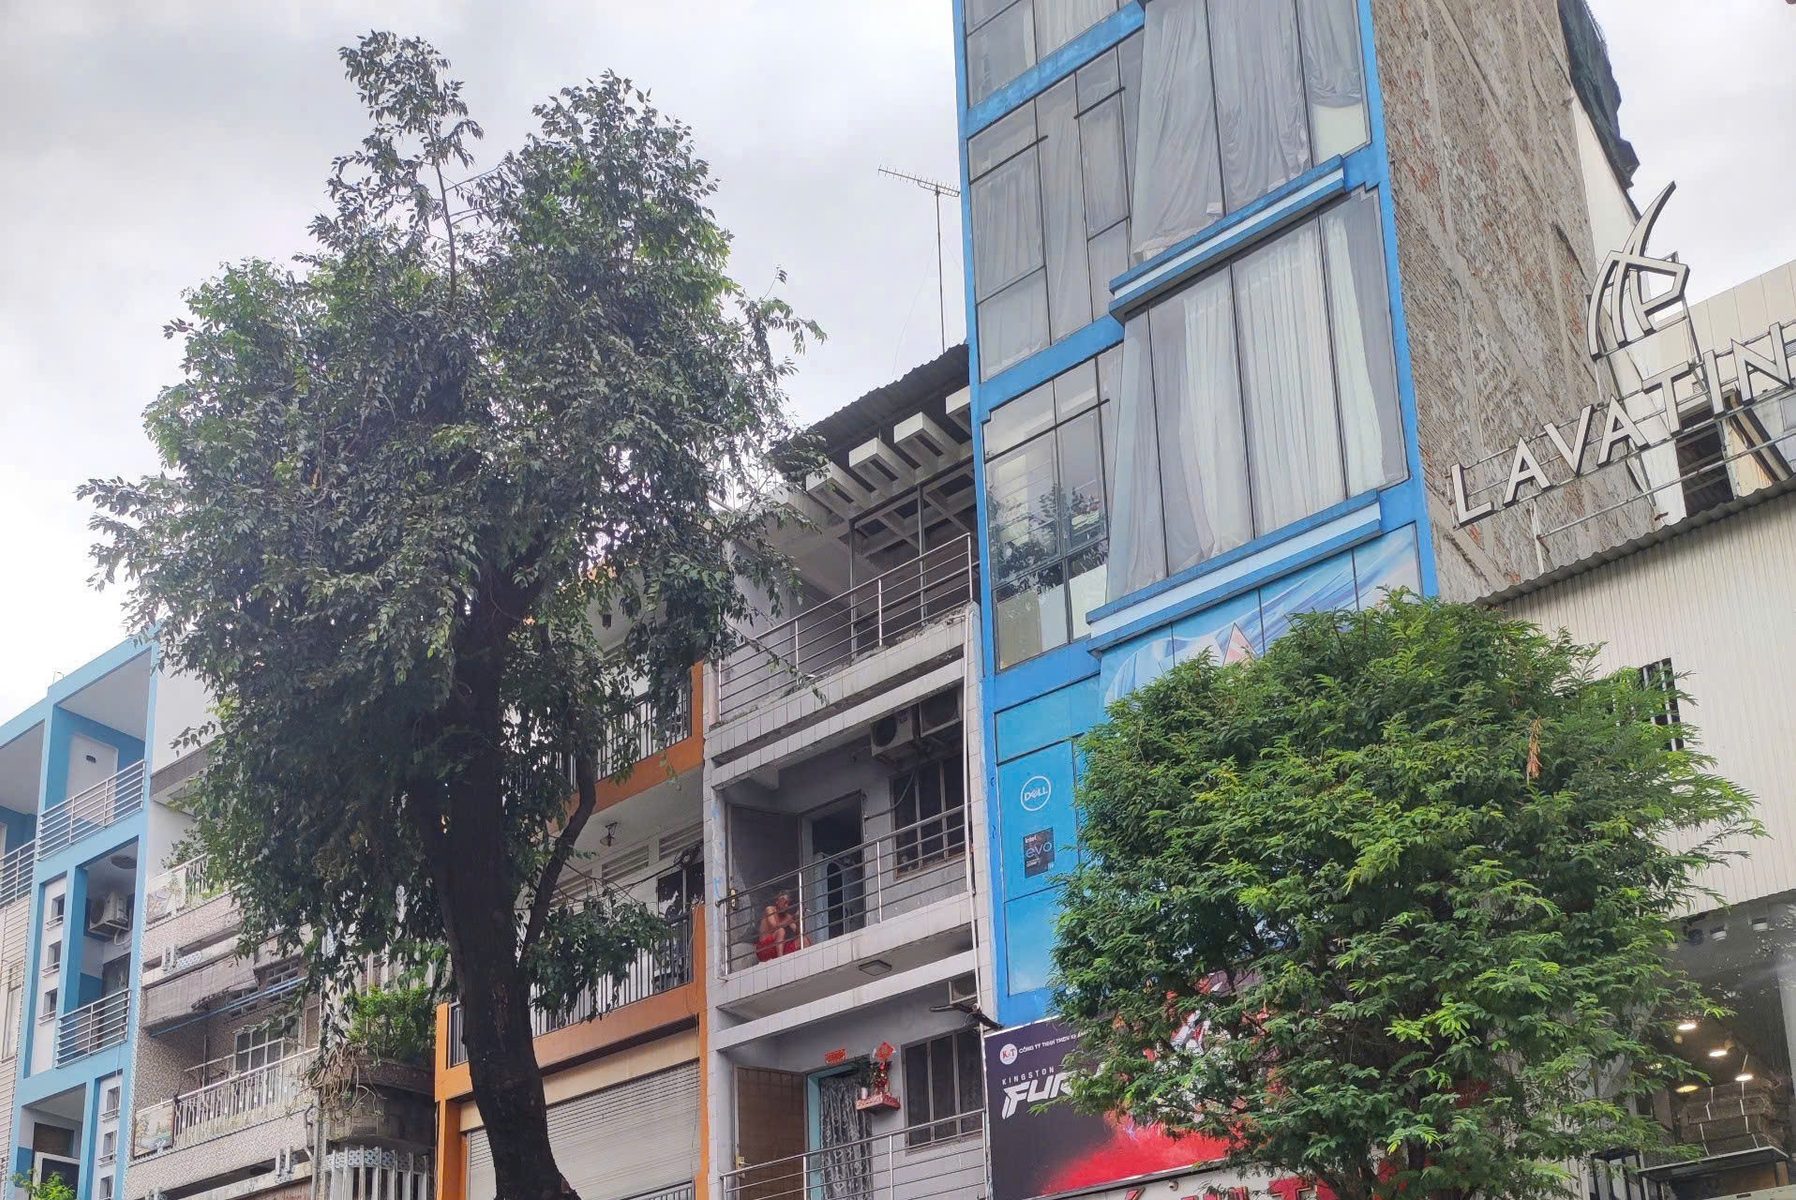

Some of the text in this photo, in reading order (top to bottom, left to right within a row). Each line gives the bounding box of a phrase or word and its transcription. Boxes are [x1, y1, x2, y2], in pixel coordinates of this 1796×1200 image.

[1024, 786, 1048, 801] DELL
[1026, 841, 1053, 858] evo
[1002, 1066, 1055, 1085] KINGSTON
[1001, 1062, 1106, 1120] FUR
